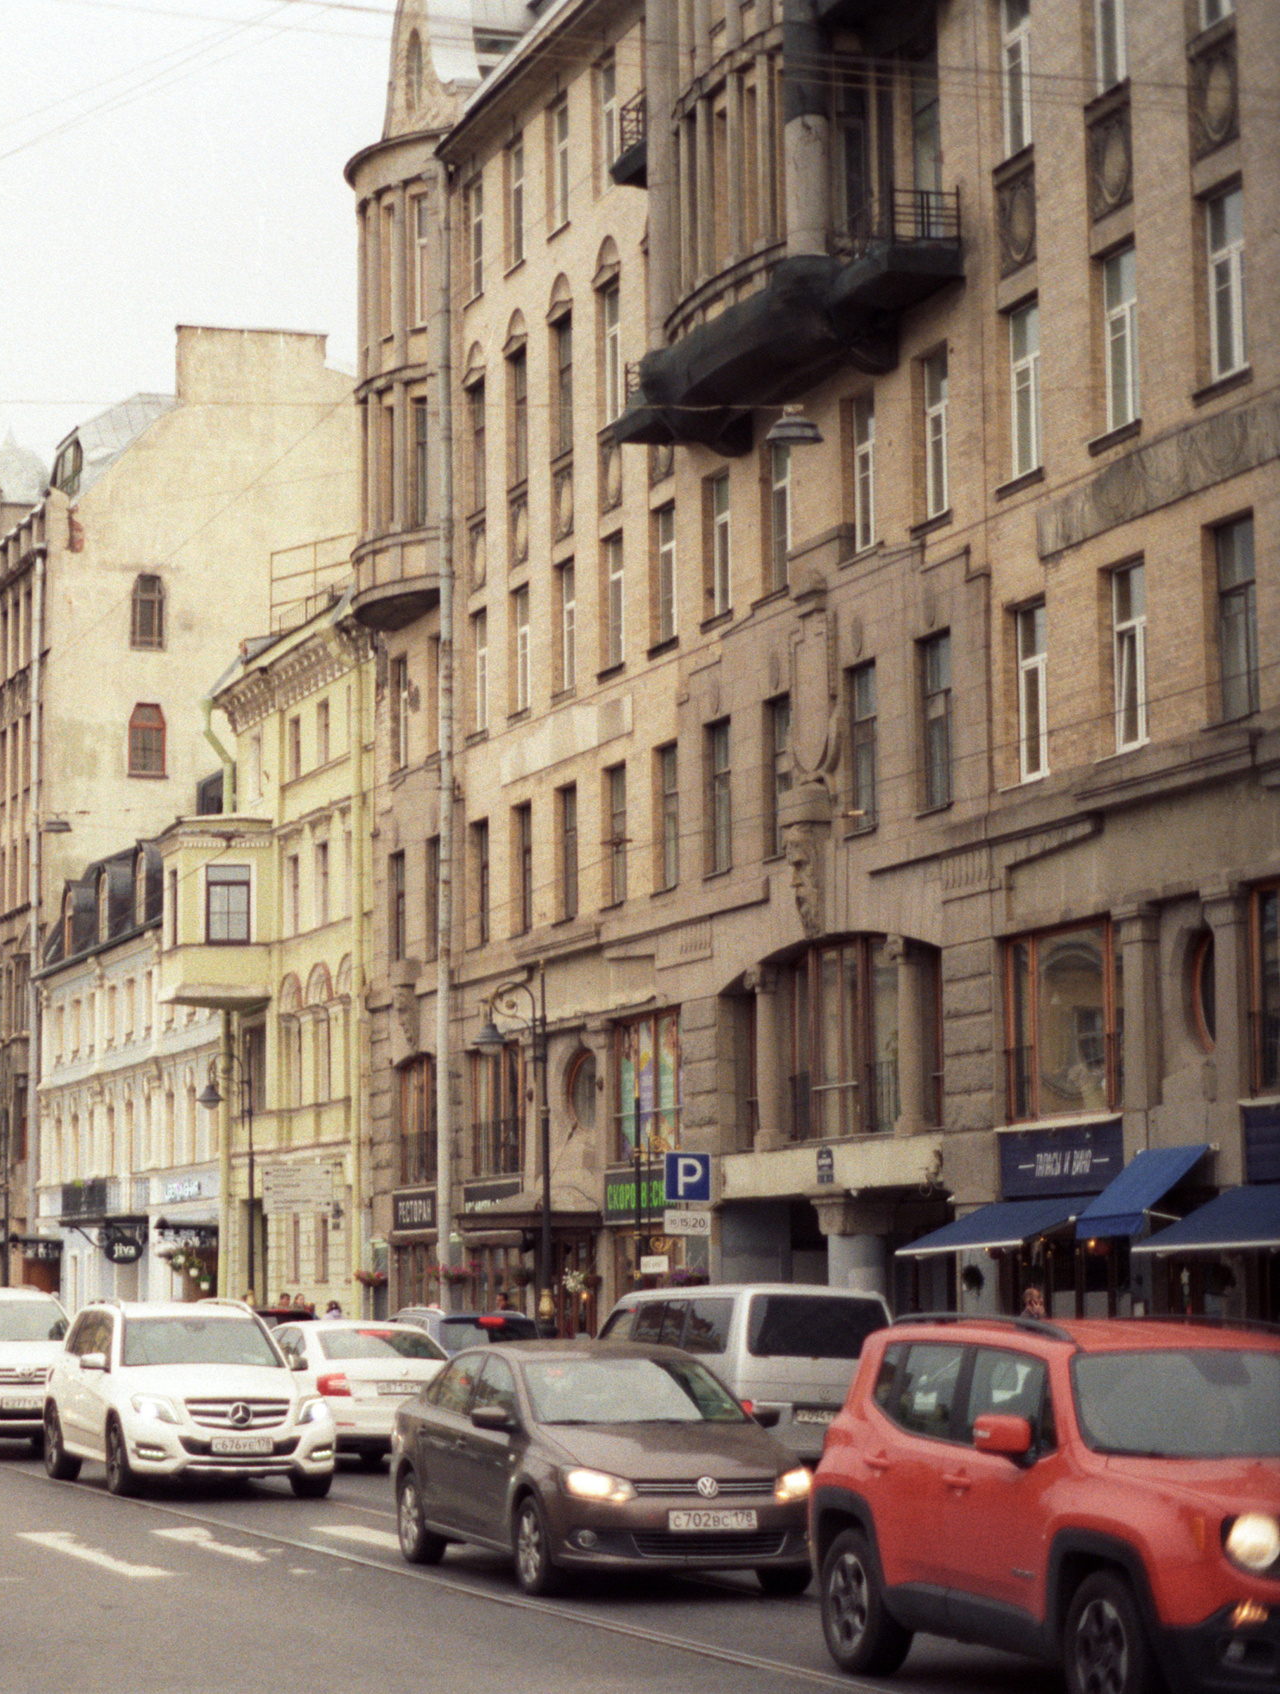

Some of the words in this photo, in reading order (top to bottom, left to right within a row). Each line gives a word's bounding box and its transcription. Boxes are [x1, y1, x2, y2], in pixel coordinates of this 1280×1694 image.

[678, 1157, 703, 1196] P
[398, 1198, 432, 1223] РЕСТОРАН
[112, 1242, 136, 1258] jiva
